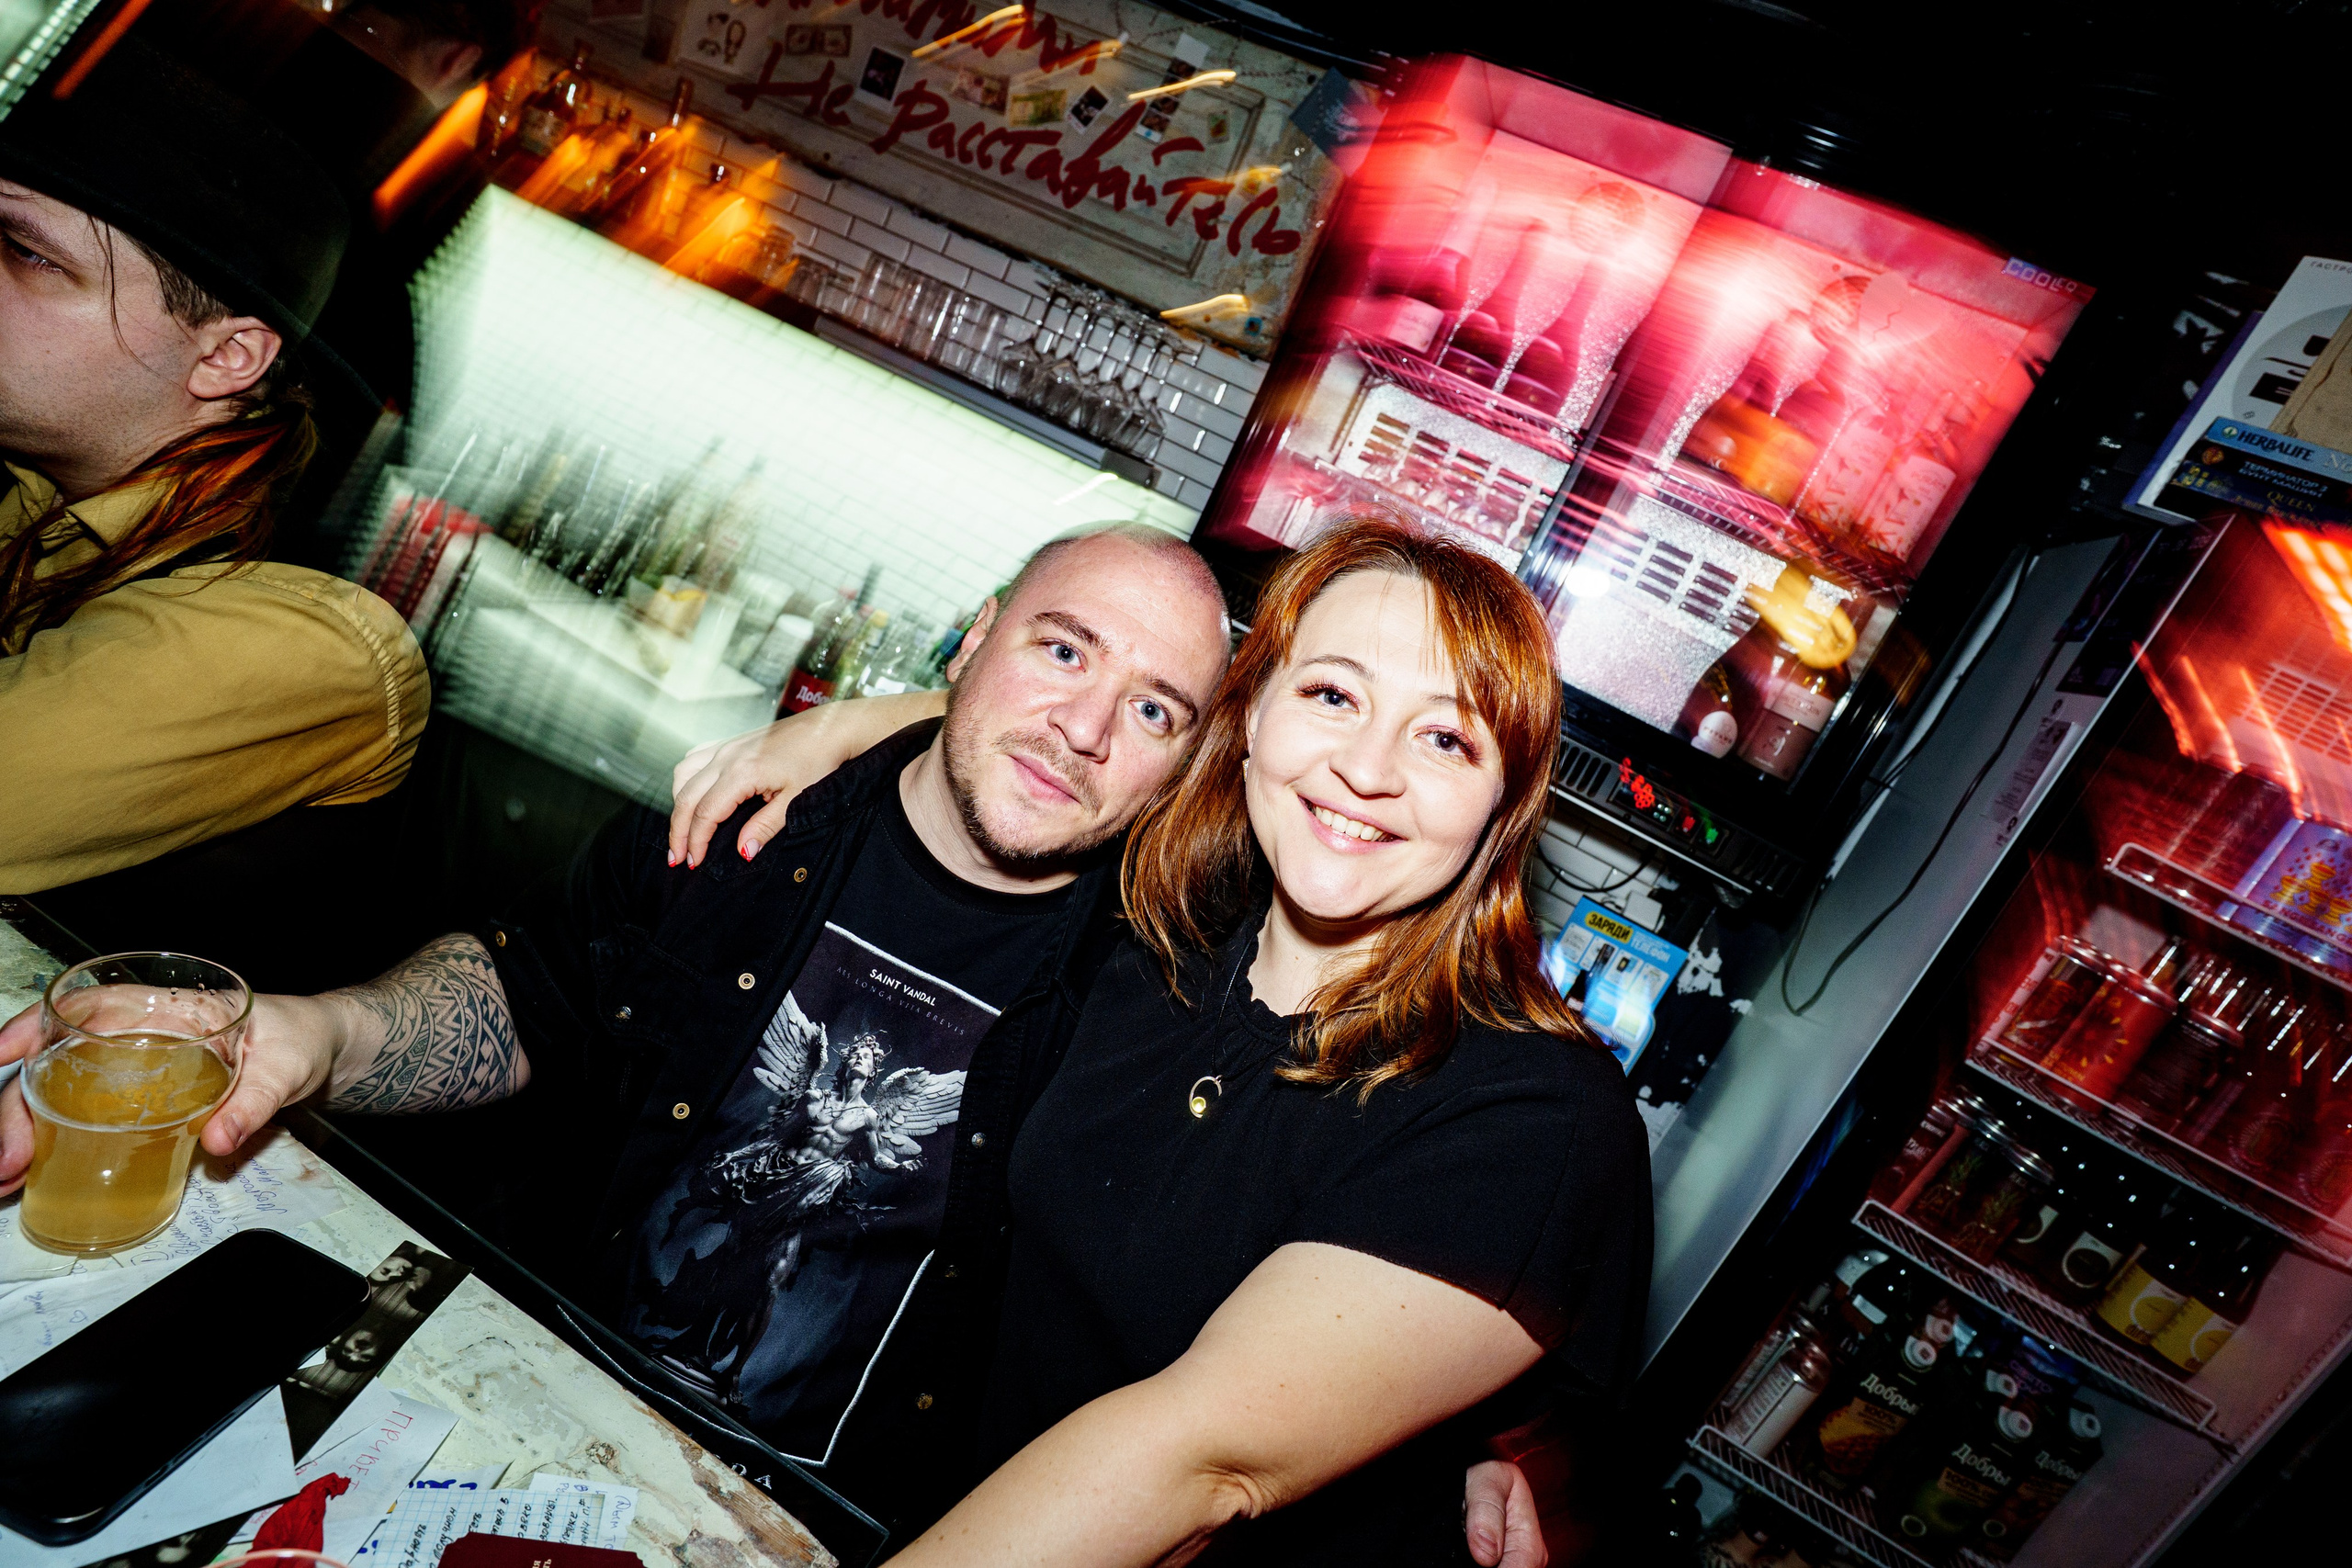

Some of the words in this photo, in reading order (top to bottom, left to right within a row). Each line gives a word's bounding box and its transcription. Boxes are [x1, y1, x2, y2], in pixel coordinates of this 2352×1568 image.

[2236, 430, 2315, 461] HERBALIFE
[2267, 490, 2316, 513] QUEEN
[796, 684, 835, 705] Добр
[1588, 913, 1631, 941] ЗАРЯДИ
[869, 967, 902, 990] SAINT
[902, 983, 937, 1007] VANDAL
[854, 977, 893, 1002] LONGA
[925, 1010, 966, 1036] BREVIS
[1951, 1442, 2012, 1487] Добры
